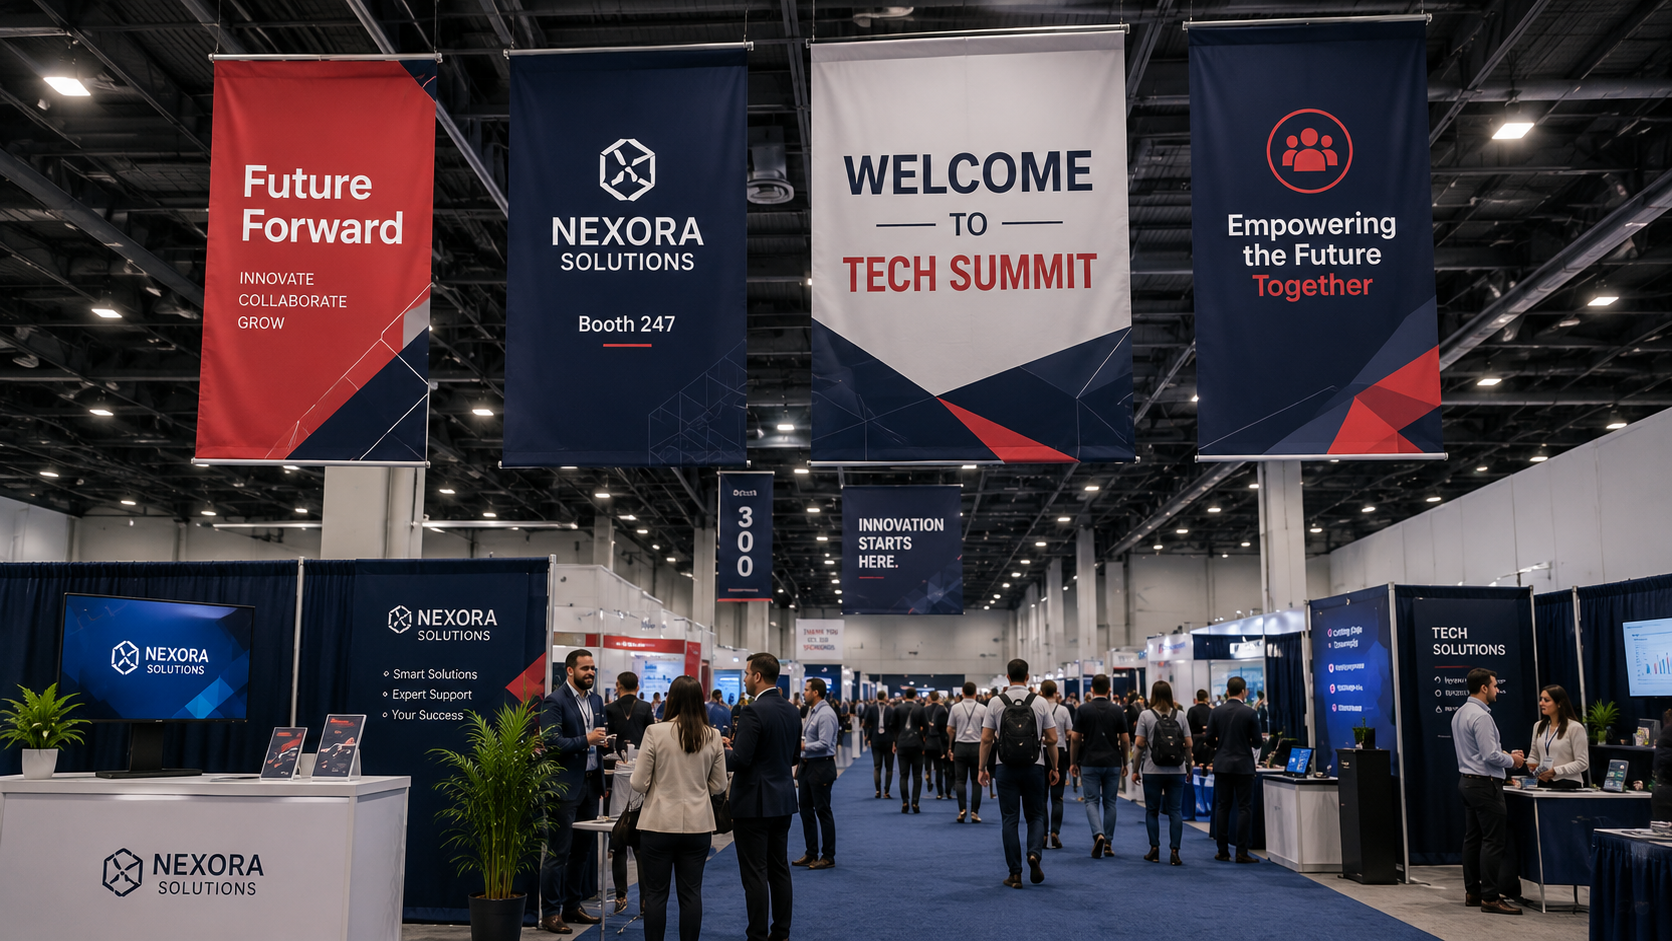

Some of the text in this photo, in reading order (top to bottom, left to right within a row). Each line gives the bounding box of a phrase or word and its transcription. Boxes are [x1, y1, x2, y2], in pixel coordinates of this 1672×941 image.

[844, 150, 1093, 196] WELCOME
[244, 163, 373, 201] Future
[242, 208, 404, 245] Forward
[552, 216, 705, 246] NEXORA
[949, 212, 988, 237] TO
[1227, 211, 1397, 242] Empowering
[560, 252, 695, 271] SOLUTIONS
[1243, 243, 1382, 267] the Future
[239, 271, 315, 286] INNOVATE
[843, 252, 1098, 292] TECH SUMMIT
[1252, 273, 1373, 302] Together
[238, 293, 348, 308] COLLABORATE
[237, 315, 285, 330] GROW
[578, 315, 676, 333] Booth 247
[858, 517, 944, 532] INNOVATION
[737, 506, 754, 577] 300
[858, 536, 913, 551] STARTS
[858, 554, 899, 569] HERE.
[417, 609, 498, 626] NEXORA
[417, 630, 491, 641] SOLUTIONS
[1431, 626, 1468, 640] TECH
[145, 646, 209, 663] NEXORA
[1433, 643, 1506, 656] SOLUTIONS
[146, 664, 205, 676] SOLUTIONS
[393, 668, 478, 680] Smart Solutions
[392, 688, 473, 704] Expert Support
[391, 709, 464, 721] Your Success
[152, 854, 264, 877] NEXORA
[158, 881, 257, 896] SOLUTIONS
